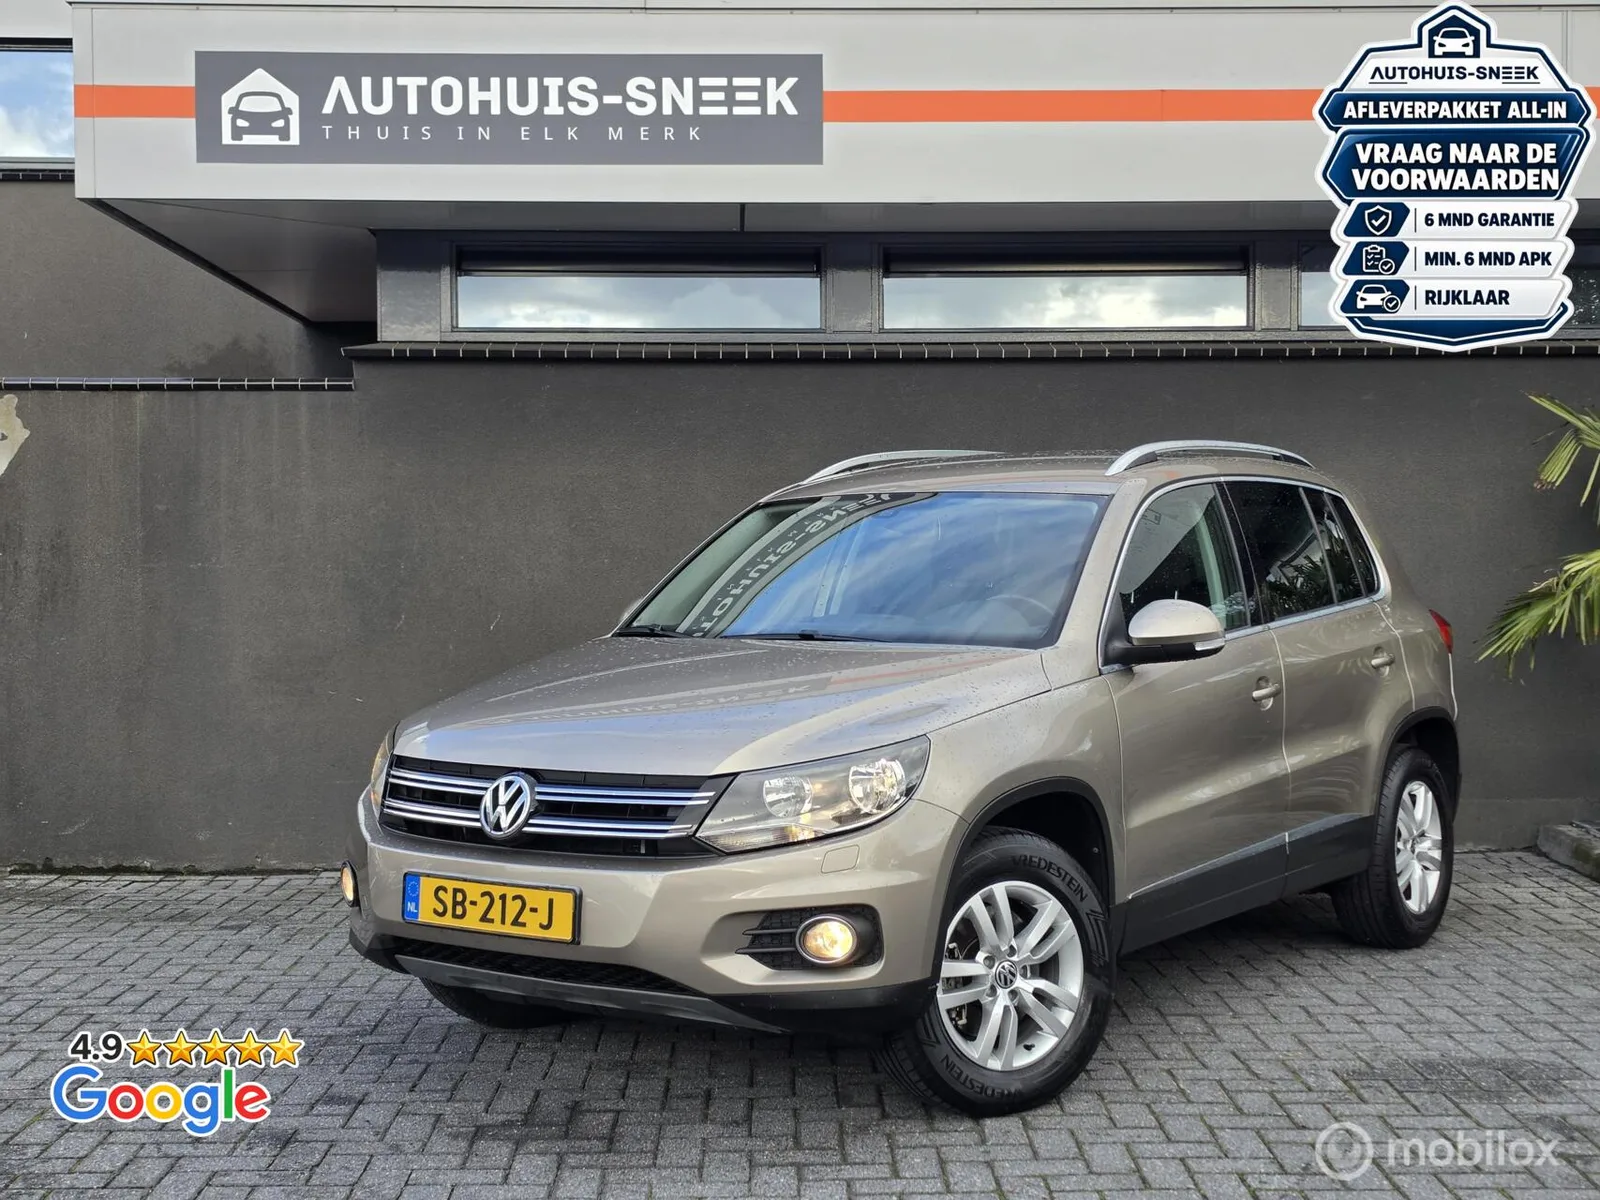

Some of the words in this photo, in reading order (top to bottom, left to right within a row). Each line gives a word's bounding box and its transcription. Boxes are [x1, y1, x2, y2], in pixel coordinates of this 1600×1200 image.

[321, 76, 799, 116] AUTOHUIS-SNEEK
[322, 126, 431, 140] THUIS
[457, 126, 490, 140] IN
[521, 126, 578, 140] ELK
[608, 126, 700, 141] MERK
[407, 901, 418, 913] NL
[432, 885, 555, 930] SB-212-J
